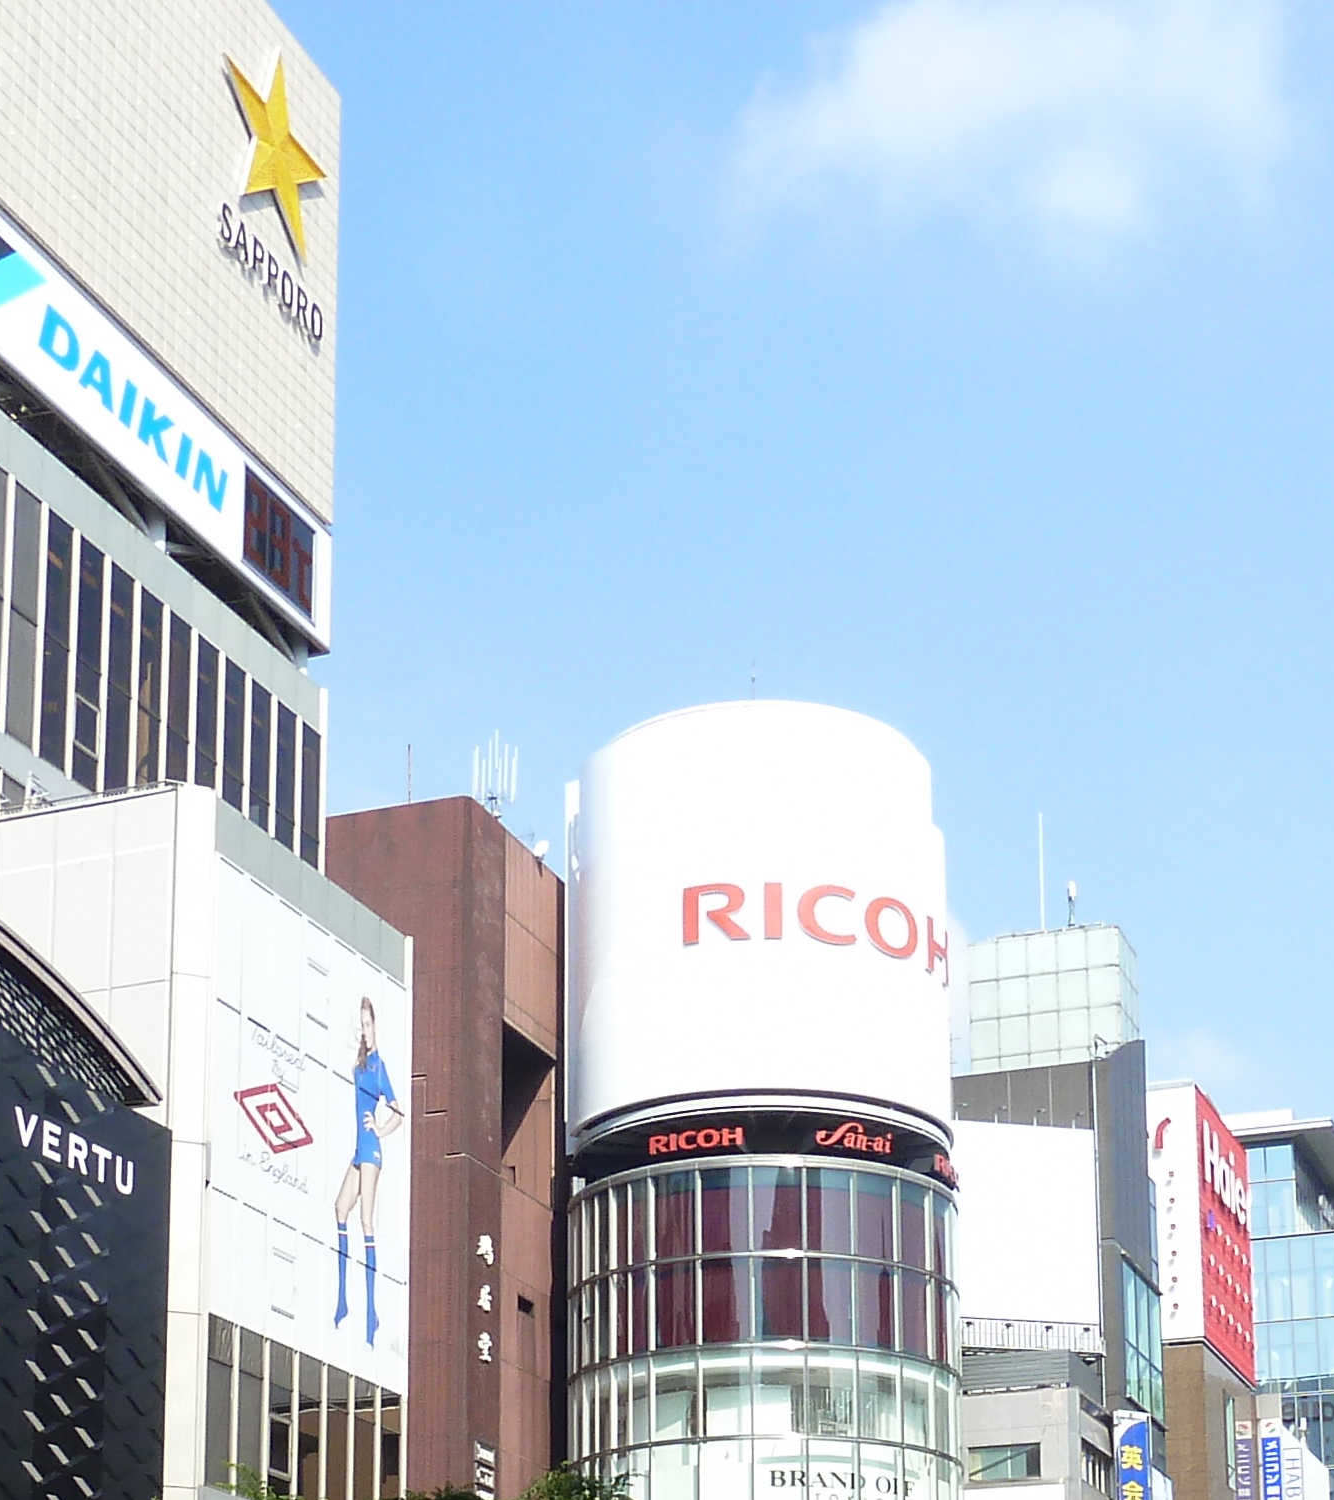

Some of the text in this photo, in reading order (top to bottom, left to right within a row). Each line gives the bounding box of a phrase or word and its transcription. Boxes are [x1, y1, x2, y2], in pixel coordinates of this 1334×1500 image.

[220, 202, 324, 342] SAPPORO
[38, 303, 228, 513] DAIKIN
[683, 882, 949, 987] RICOH
[14, 1106, 134, 1195] VERTU
[649, 1126, 745, 1155] RICOH
[816, 1122, 893, 1154] San-ai
[770, 1469, 865, 1491] BRAND
